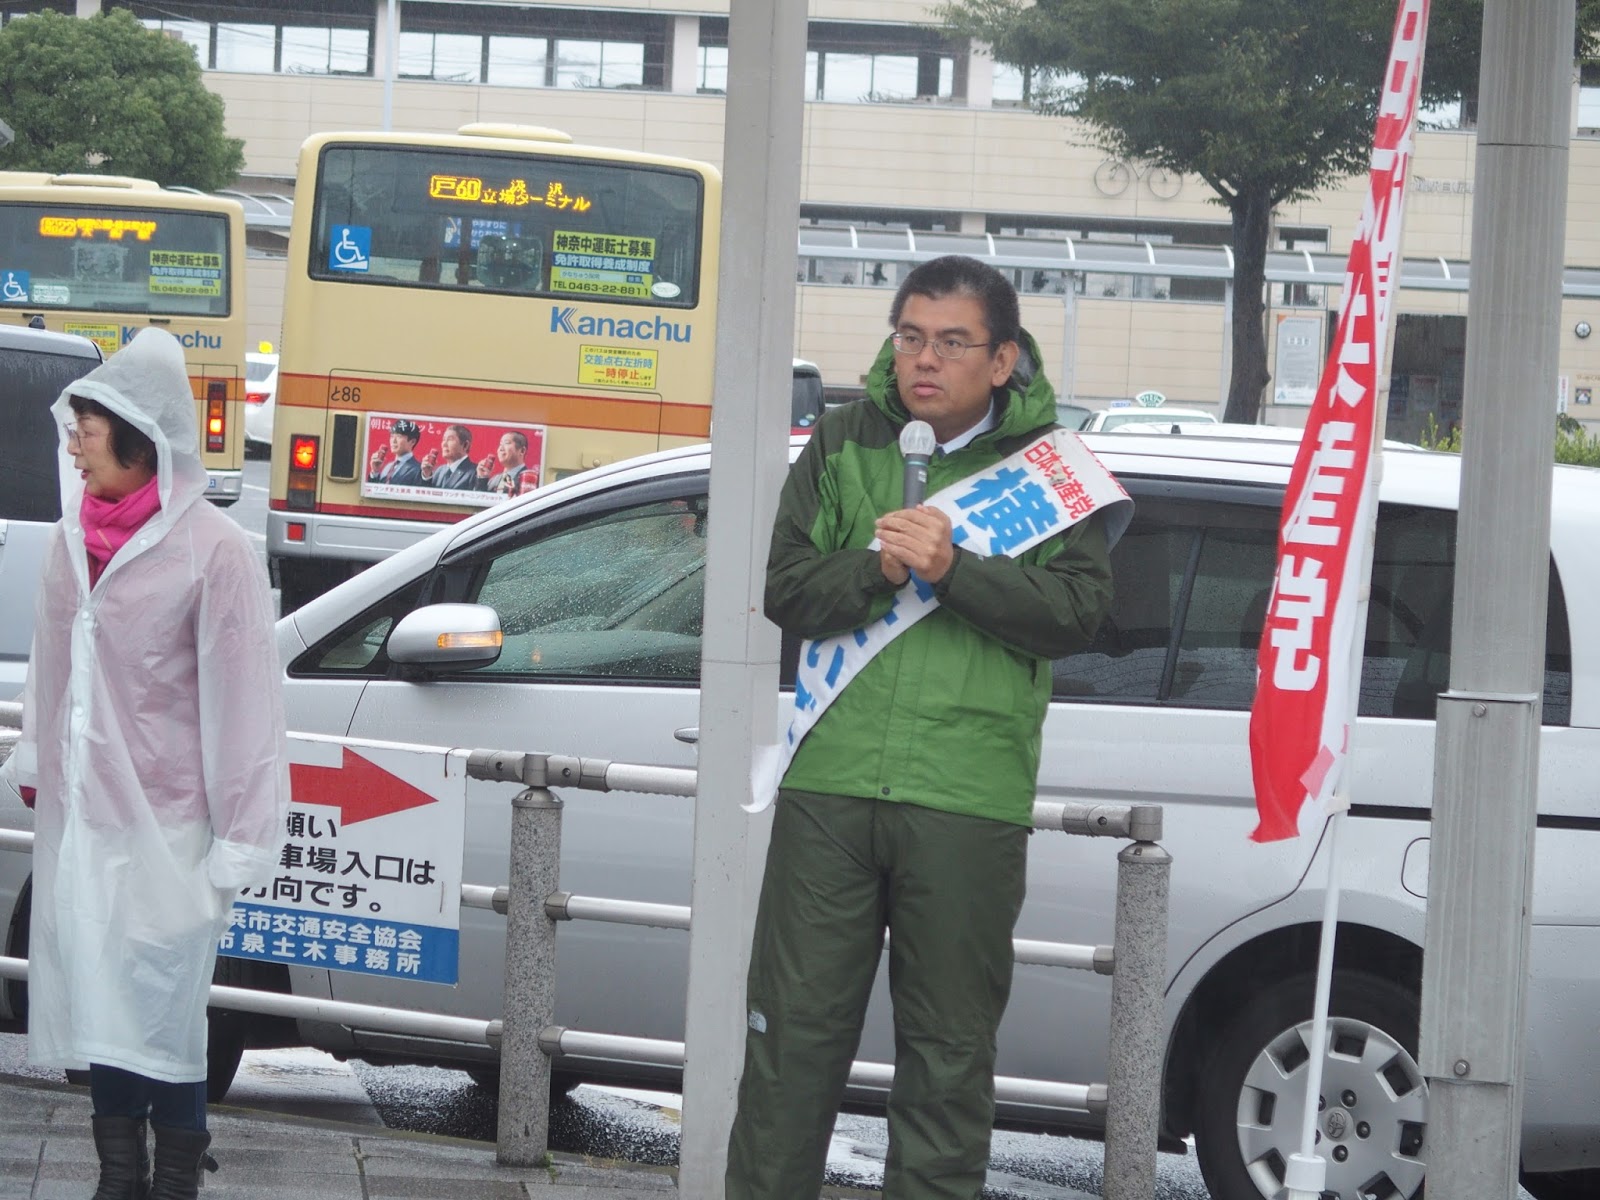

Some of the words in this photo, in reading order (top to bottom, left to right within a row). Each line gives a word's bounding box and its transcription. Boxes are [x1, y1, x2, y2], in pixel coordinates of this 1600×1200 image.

[434, 177, 480, 200] 戸60
[556, 234, 652, 258] 神奈中運転士募集
[152, 252, 219, 268] 神奈中運転士募集
[554, 253, 651, 273] 免許取得養成制度
[553, 280, 567, 289] TEL
[568, 281, 649, 296] 0463-22-8811
[550, 306, 691, 343] Kanachu
[122, 326, 221, 349] Kchu
[584, 354, 653, 370] 交差点右左折時
[331, 386, 361, 403] と86
[370, 418, 442, 435] 朝は、キリッと。
[279, 843, 436, 885] 車場入口は
